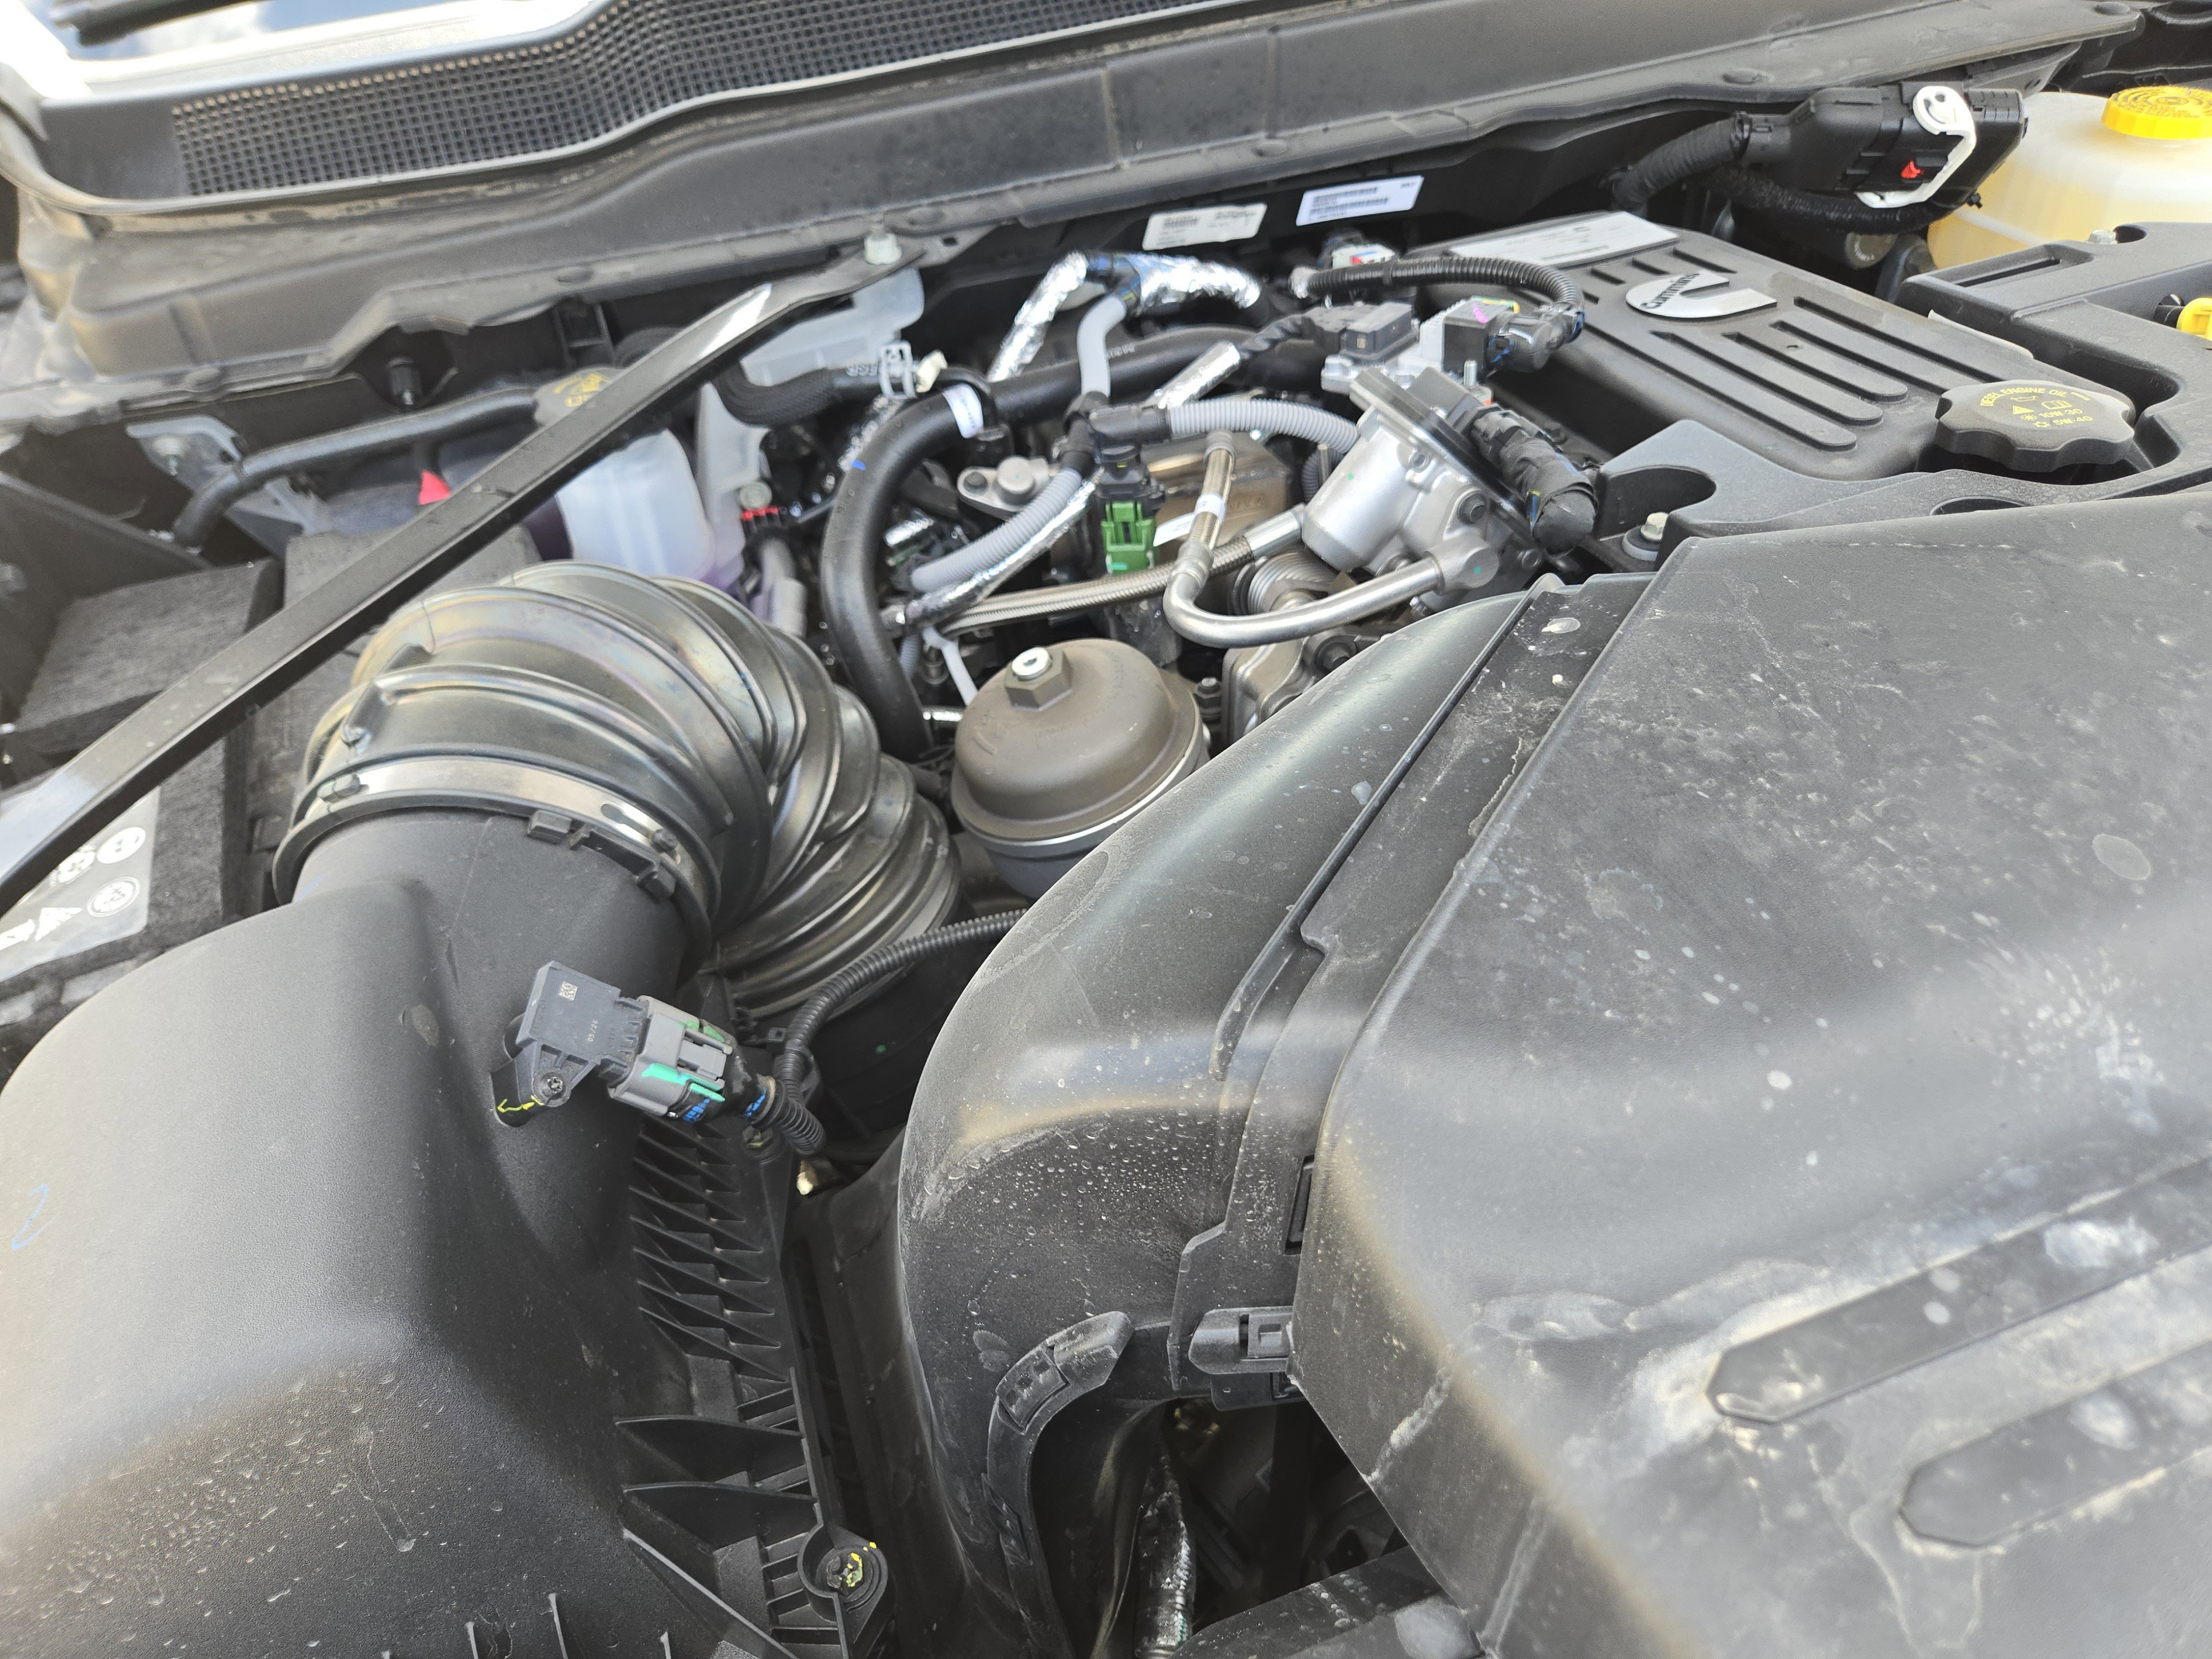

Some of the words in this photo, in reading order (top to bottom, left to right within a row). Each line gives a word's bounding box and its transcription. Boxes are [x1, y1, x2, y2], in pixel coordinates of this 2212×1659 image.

[1640, 273, 1700, 309] Cummins
[2048, 389, 2067, 398] OIL
[2038, 408, 2083, 419] 10W-30
[2052, 416, 2093, 425] 5W-40
